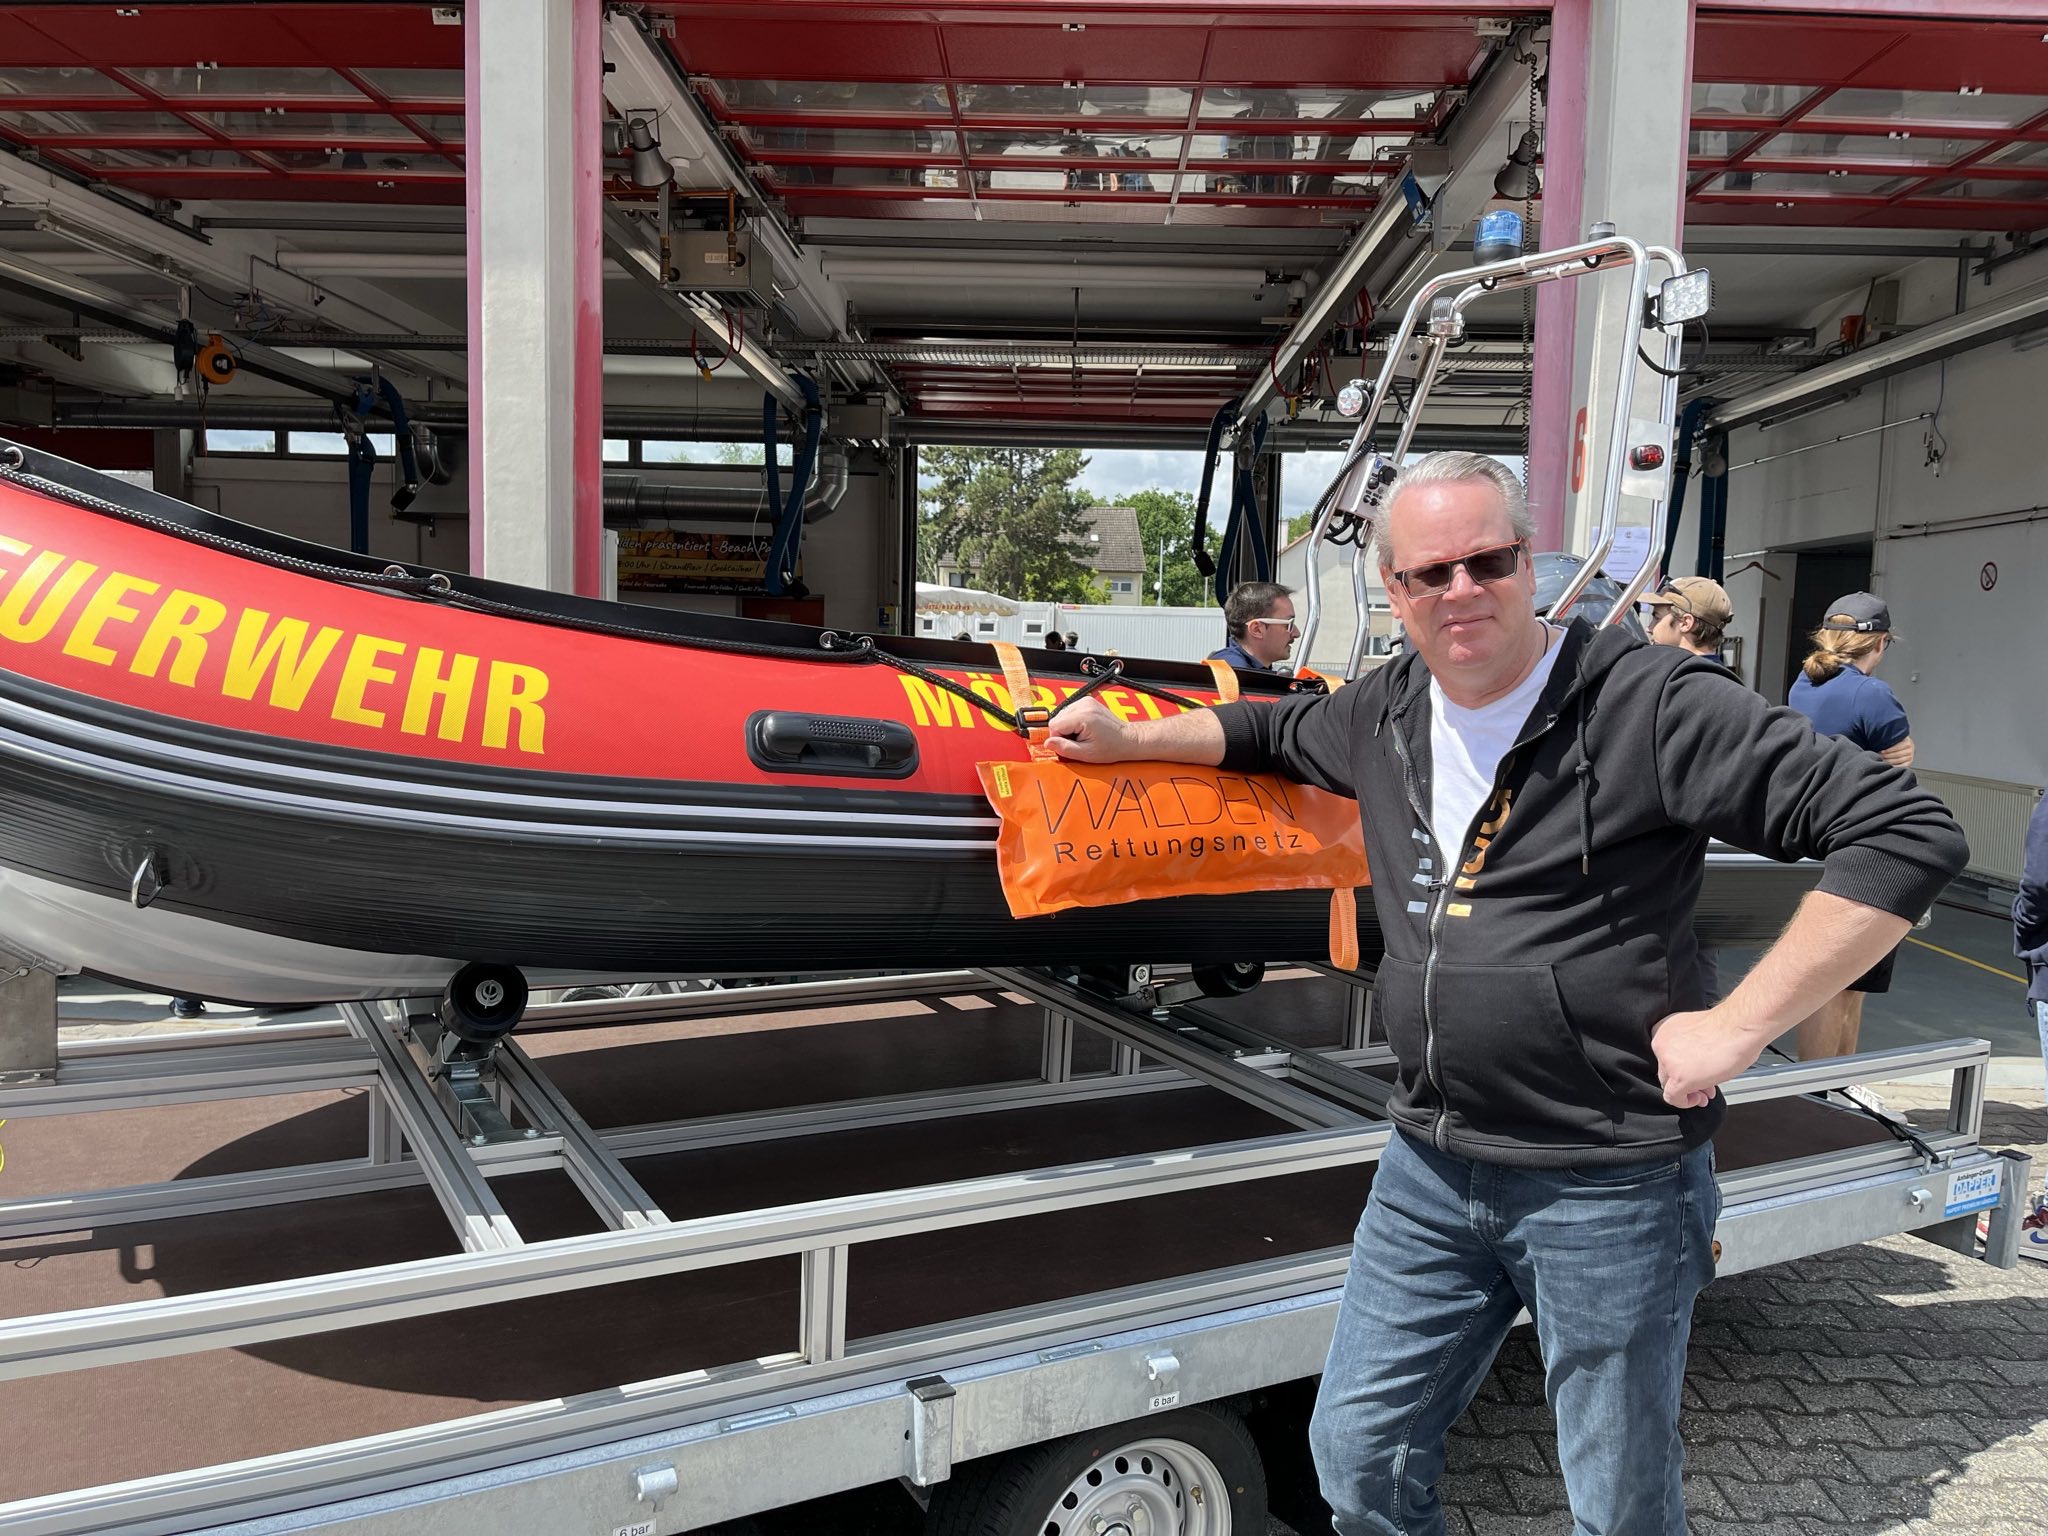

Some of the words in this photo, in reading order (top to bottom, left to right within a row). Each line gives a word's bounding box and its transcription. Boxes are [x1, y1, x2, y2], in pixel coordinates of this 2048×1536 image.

[645, 540, 711, 553] präsentiert
[1038, 776, 1295, 834] WALDEN
[1055, 834, 1302, 863] Rettungsnetz
[1956, 1176, 1993, 1194] DAPPER
[1154, 1398, 1159, 1407] 6
[1162, 1396, 1175, 1406] bar
[632, 1525, 650, 1536] bar
